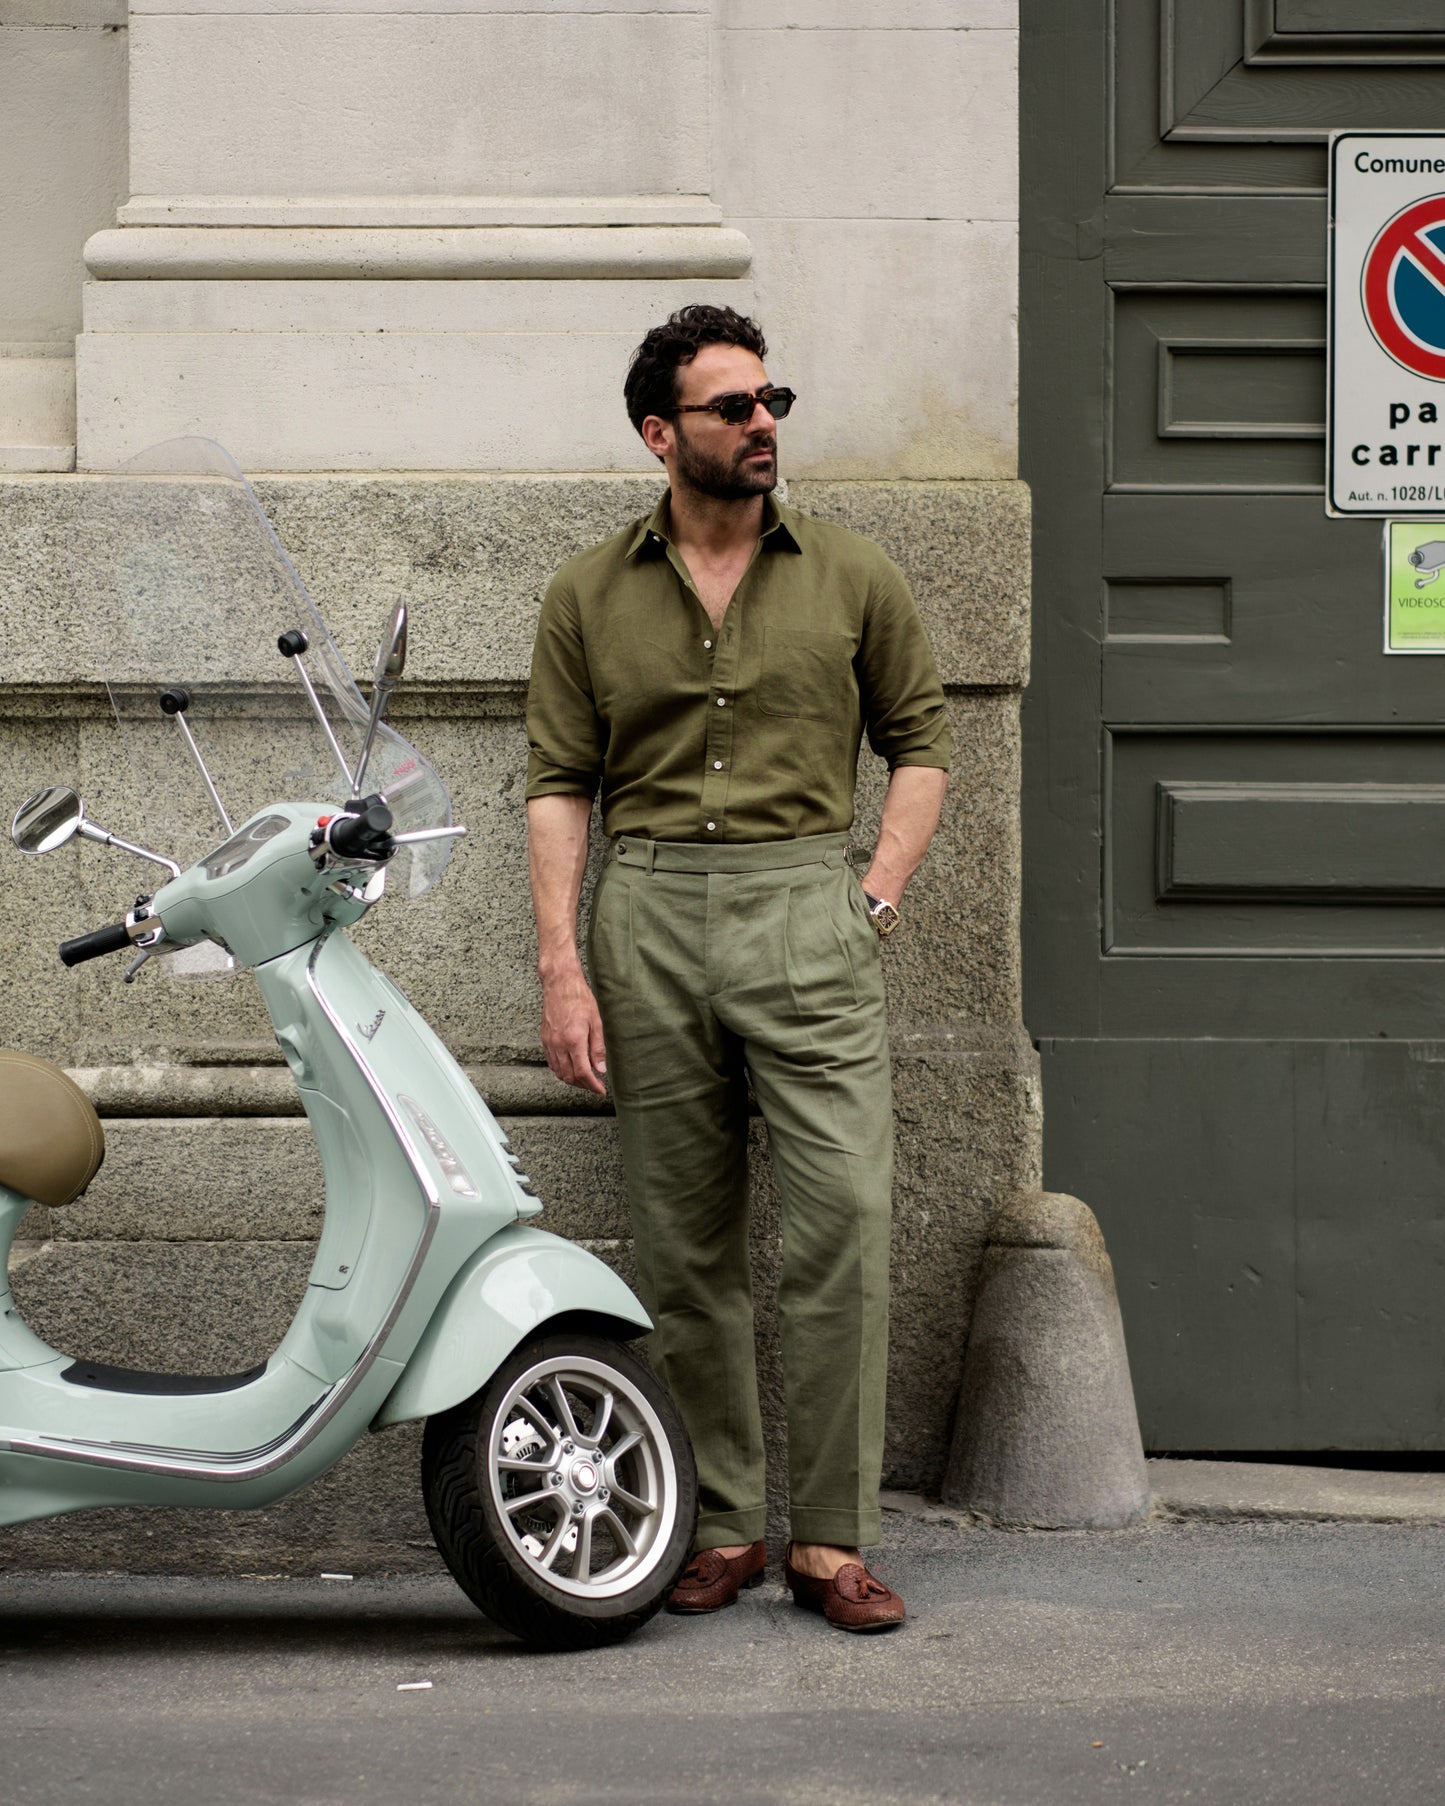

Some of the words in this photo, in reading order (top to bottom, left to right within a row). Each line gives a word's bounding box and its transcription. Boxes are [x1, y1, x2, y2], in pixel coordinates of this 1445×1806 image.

[1354, 151, 1445, 173] Comune
[1389, 402, 1437, 429] pa
[1351, 444, 1441, 466] carr
[1348, 490, 1373, 501] Aut.
[1377, 492, 1388, 501] n.
[1391, 485, 1445, 501] 1028/L
